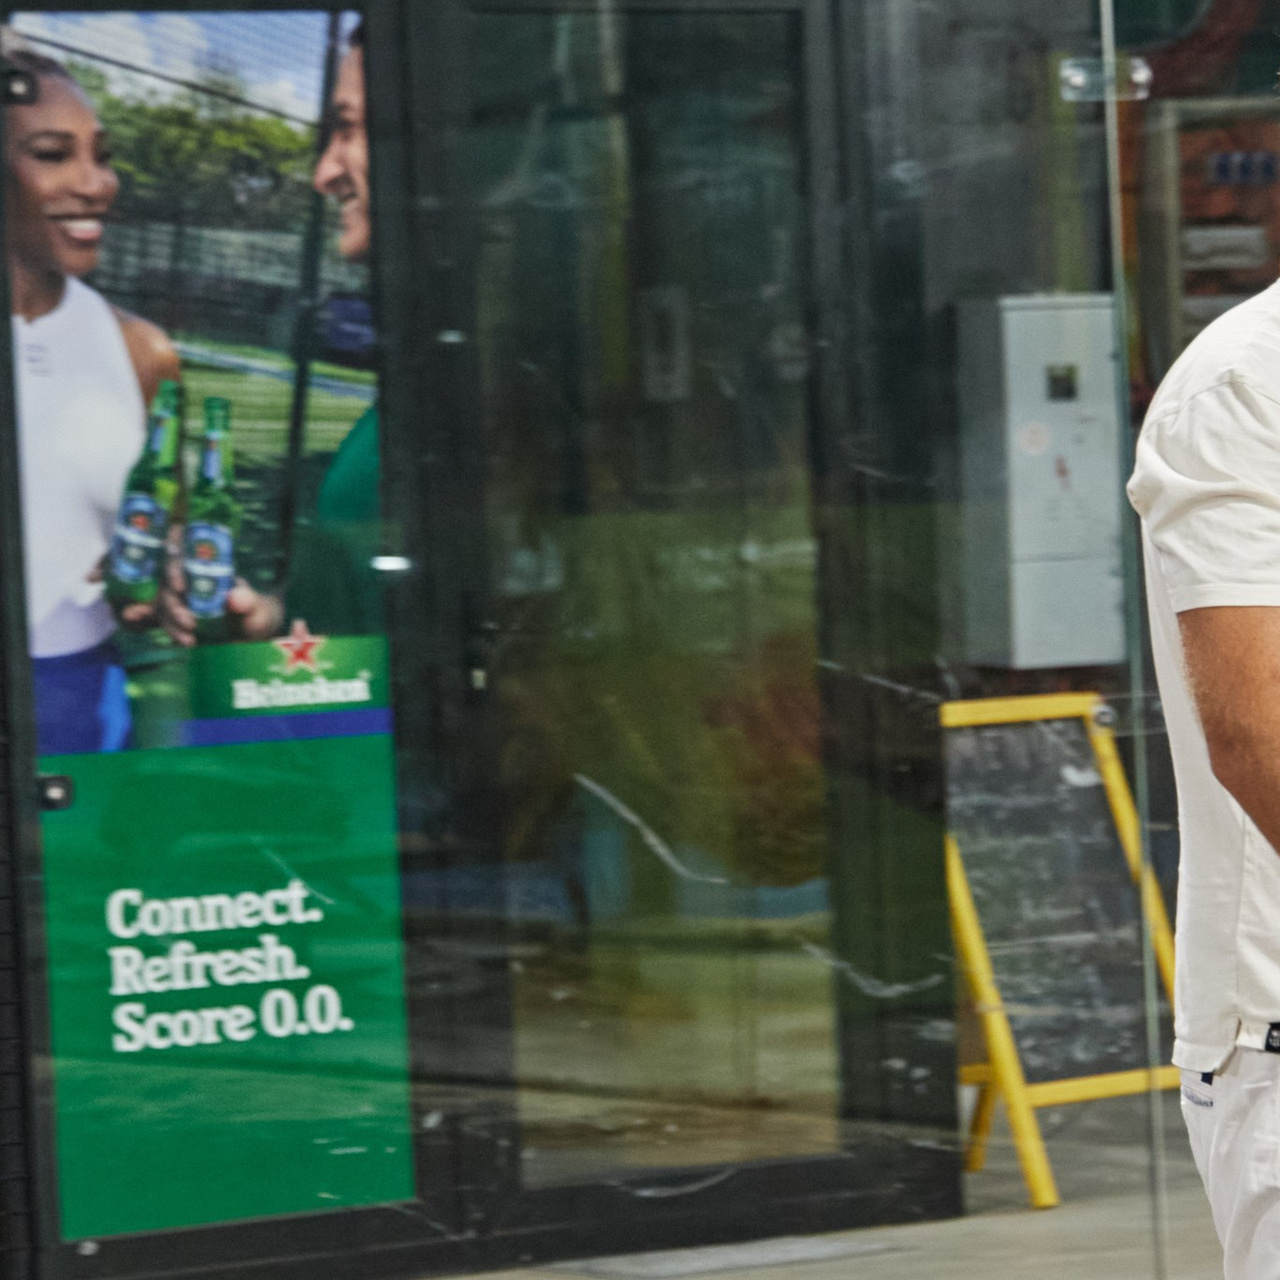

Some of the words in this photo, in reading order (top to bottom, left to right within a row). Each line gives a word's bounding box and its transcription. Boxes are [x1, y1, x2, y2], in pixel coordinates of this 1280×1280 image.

[105, 877, 324, 939] Connect.
[107, 933, 311, 995] Refresh.
[112, 1001, 256, 1053] Score
[260, 984, 355, 1038] 0.0.
